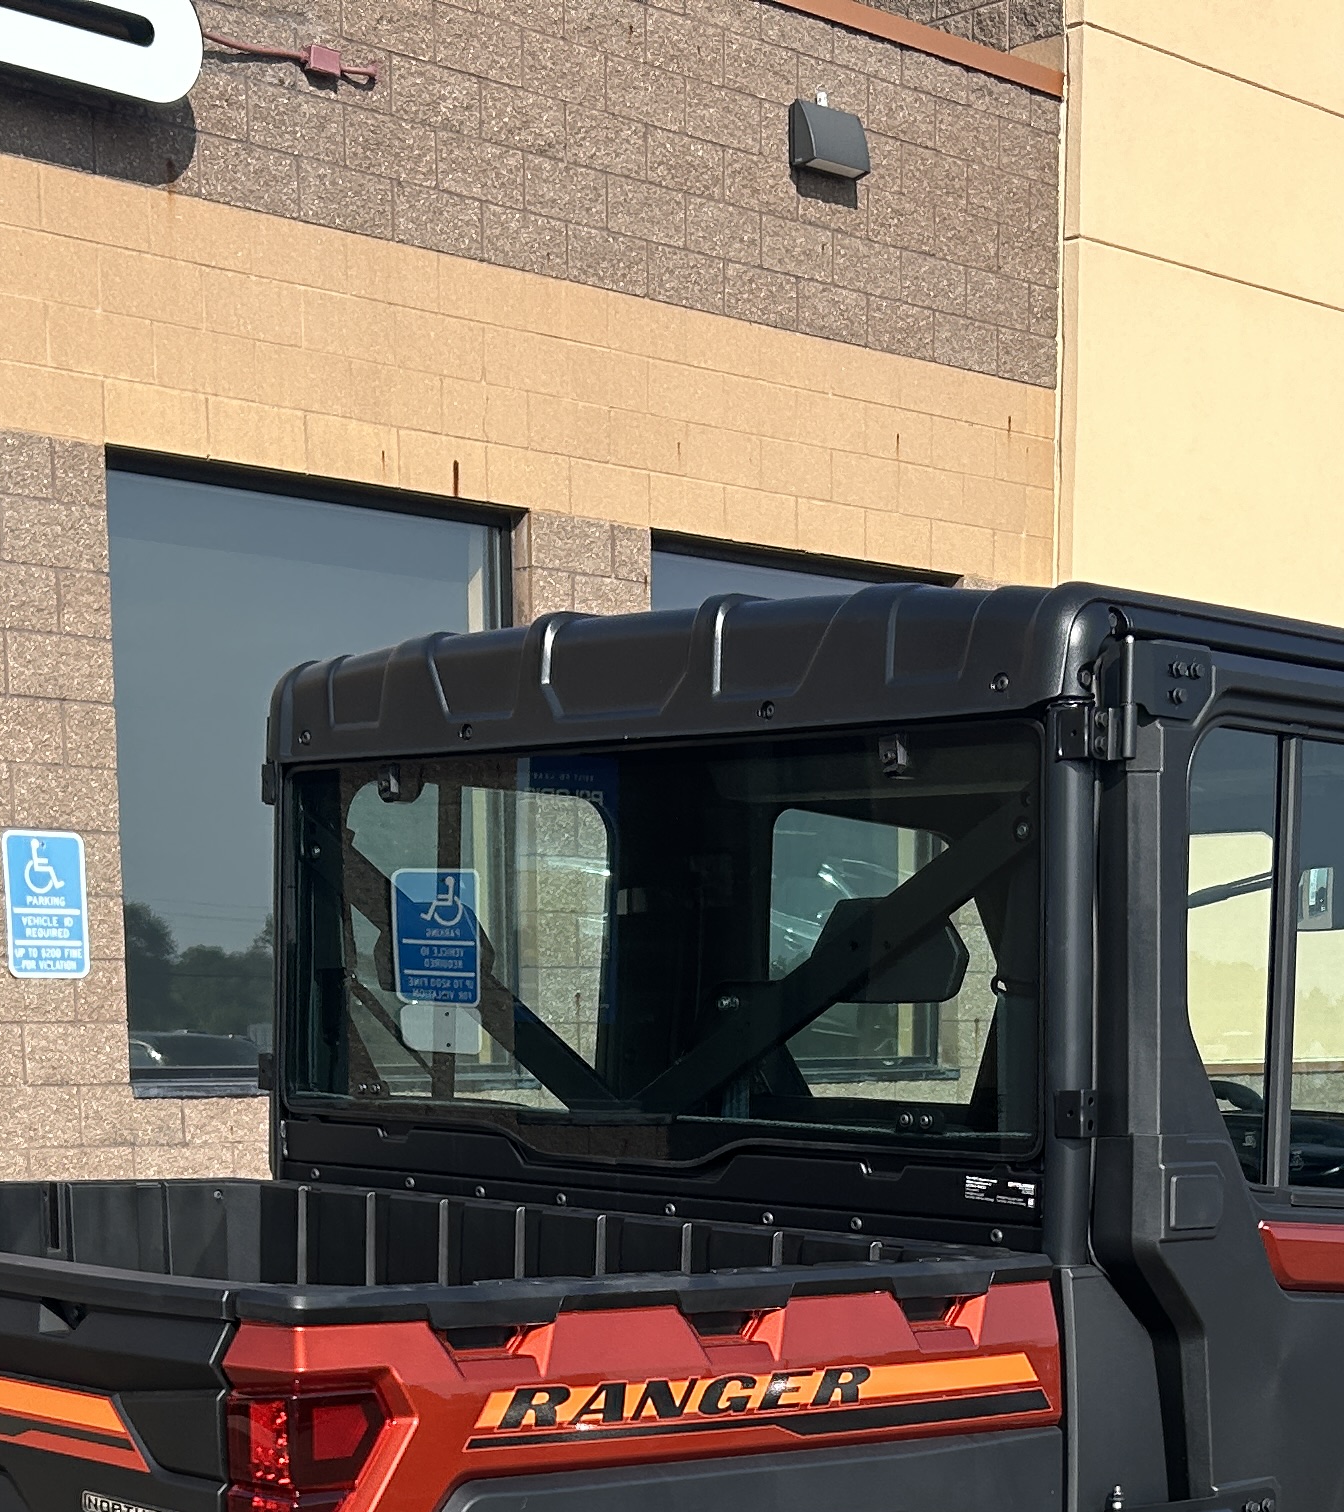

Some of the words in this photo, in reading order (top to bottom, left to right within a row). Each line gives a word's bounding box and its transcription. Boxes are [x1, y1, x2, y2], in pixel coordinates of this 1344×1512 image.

[26, 895, 66, 907] PARKING
[21, 916, 59, 927] VEHICLE
[25, 927, 70, 938] REQUIRED
[40, 947, 62, 959] $200
[64, 948, 83, 959] FINE
[494, 1364, 872, 1430] RANGER
